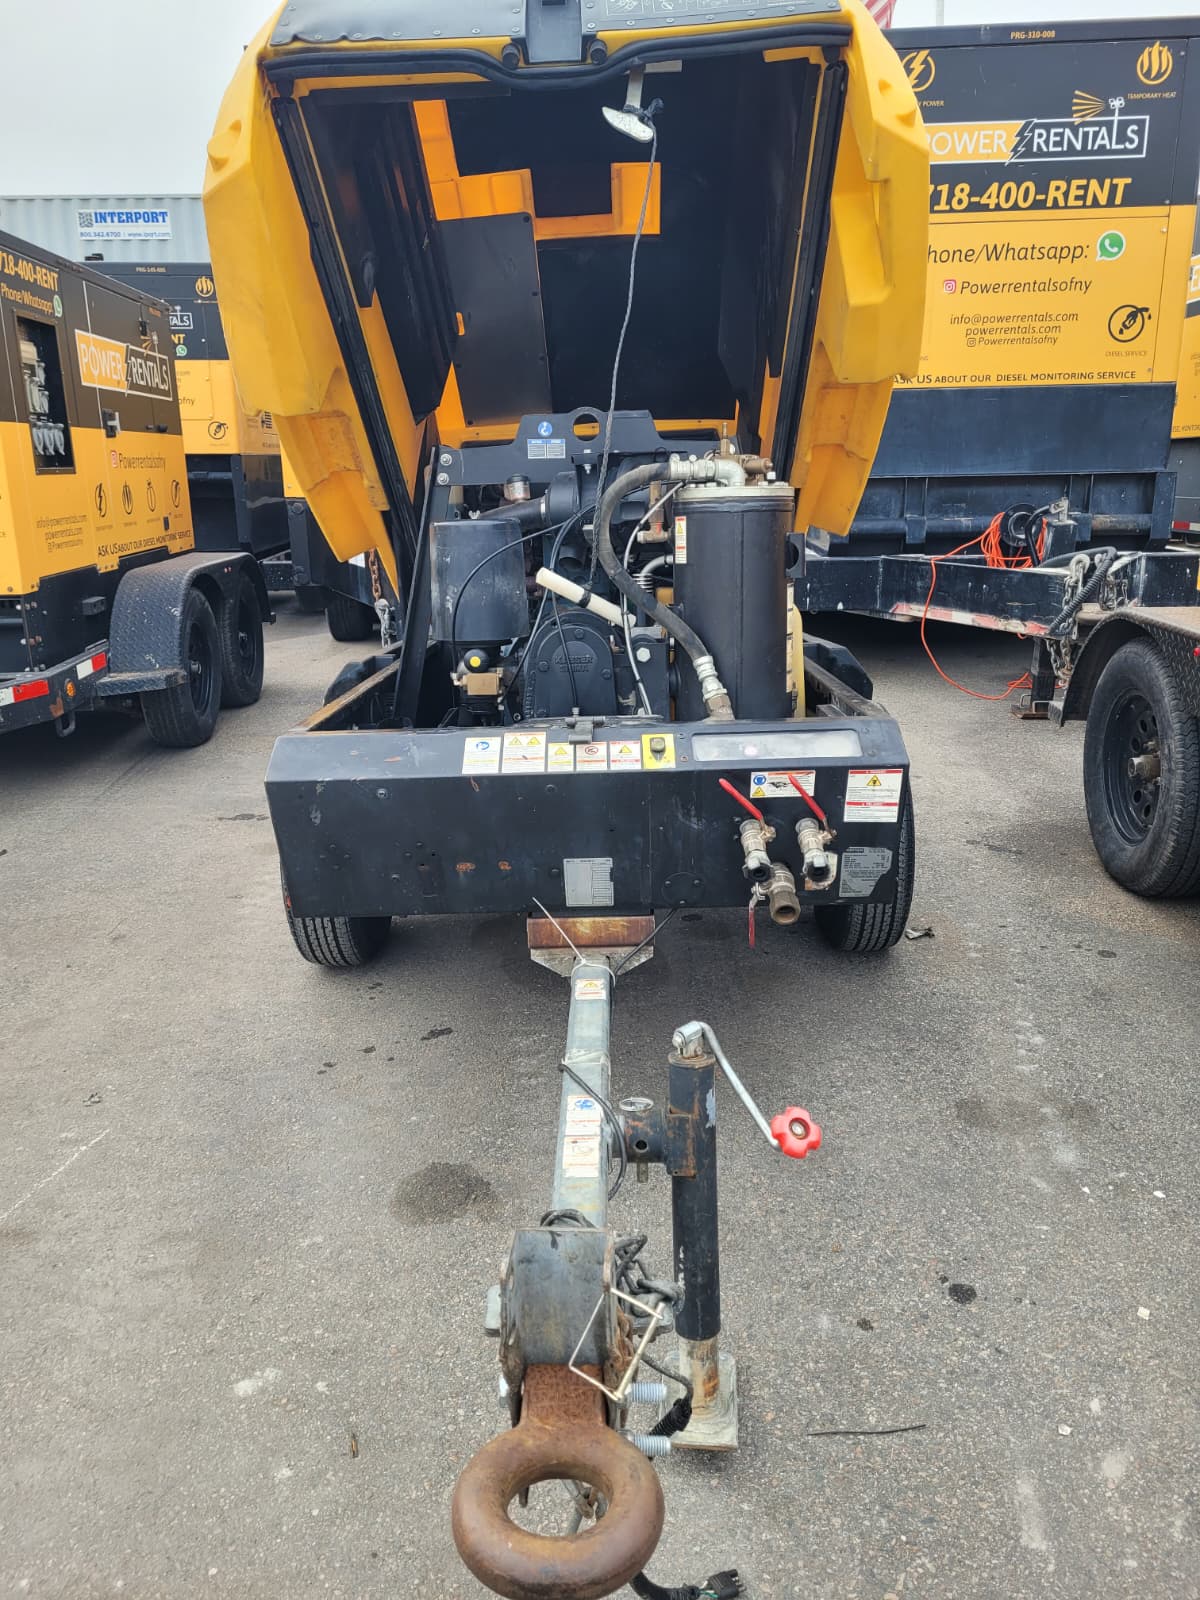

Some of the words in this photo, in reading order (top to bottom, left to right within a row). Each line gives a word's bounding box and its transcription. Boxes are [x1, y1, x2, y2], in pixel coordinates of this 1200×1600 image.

[925, 131, 1008, 156] OWER
[1033, 124, 1139, 152] RENTALS
[94, 211, 169, 224] INTERPORT
[960, 277, 1092, 295] Powerrentalsofny
[950, 312, 1079, 326] info@powerrentals.com
[965, 325, 1062, 338] powerrentals.com
[978, 335, 1059, 346] Powerrentalsofny
[80, 344, 126, 381] POWER
[130, 356, 168, 391] RENTALS
[916, 375, 932, 384] US
[935, 375, 967, 384] ABOUT
[970, 374, 991, 383] OUR
[996, 372, 1027, 382] DIESEL
[1030, 370, 1095, 381] MONITORING
[1096, 370, 1137, 379] SERVICE
